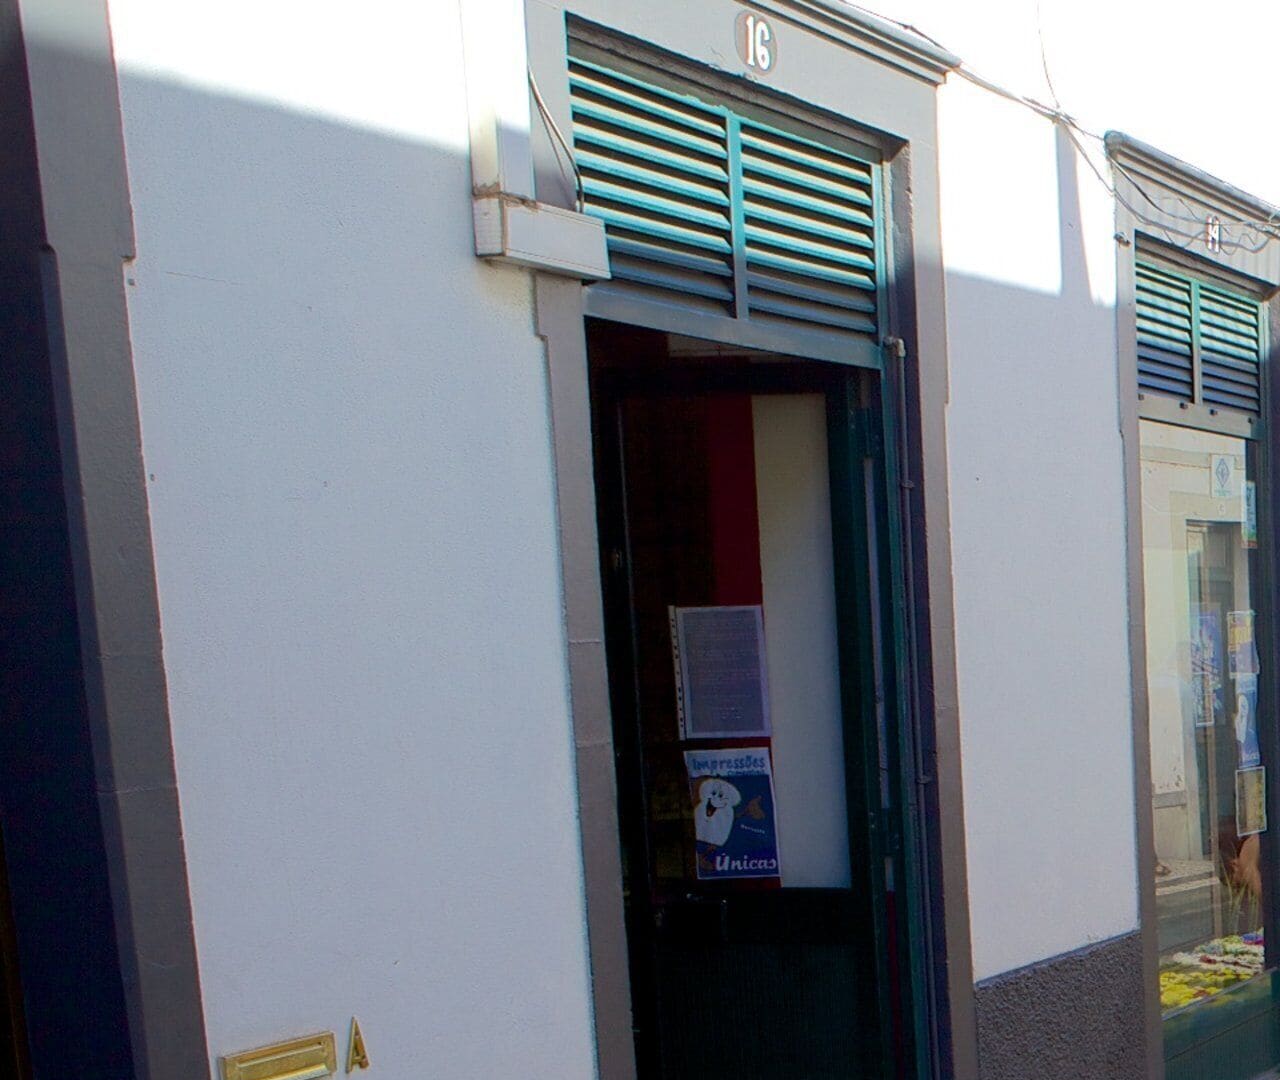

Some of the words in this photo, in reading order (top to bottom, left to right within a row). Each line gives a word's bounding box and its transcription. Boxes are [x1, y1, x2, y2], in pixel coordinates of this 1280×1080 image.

[746, 15, 771, 70] 16
[692, 755, 766, 771] Impressões
[714, 853, 778, 873] Únicas
[345, 1015, 370, 1074] A
